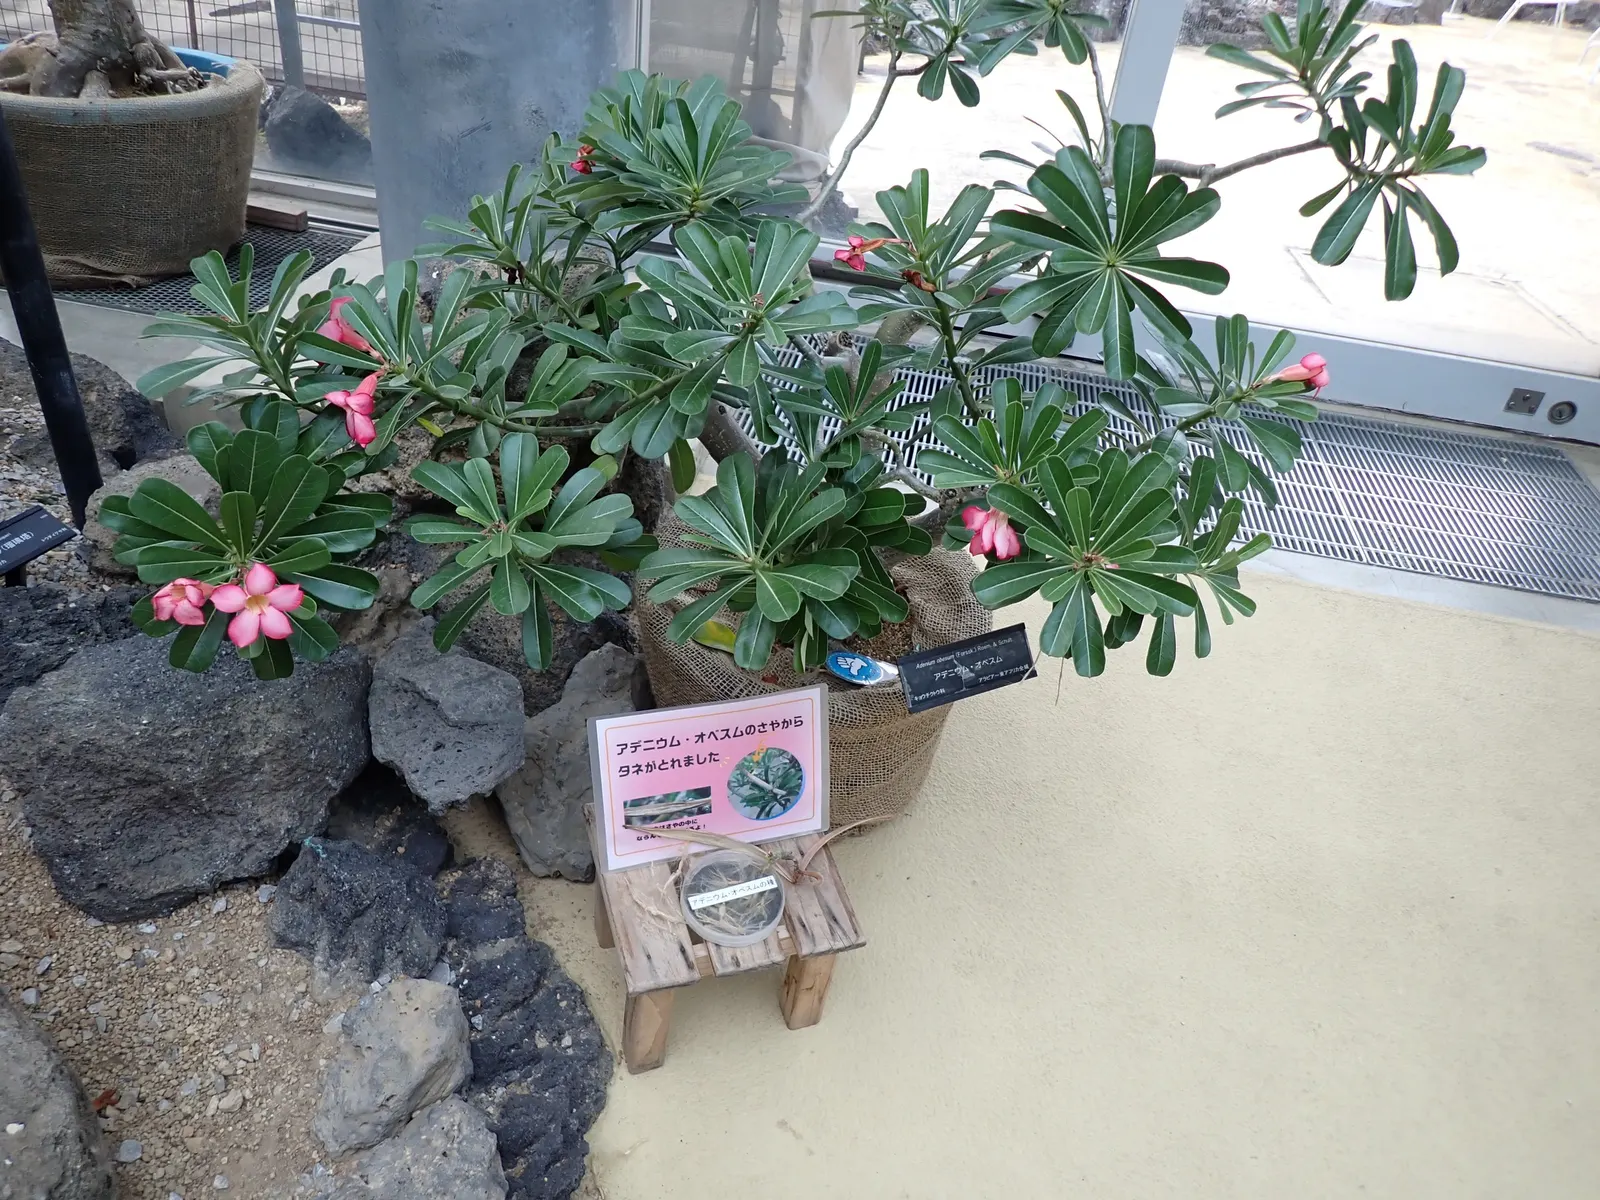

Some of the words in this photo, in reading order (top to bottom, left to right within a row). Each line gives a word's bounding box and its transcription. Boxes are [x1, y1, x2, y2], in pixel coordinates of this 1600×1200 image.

[616, 715, 804, 756] アデニウム・オベスムのさやから
[618, 752, 720, 778] タネがとれました
